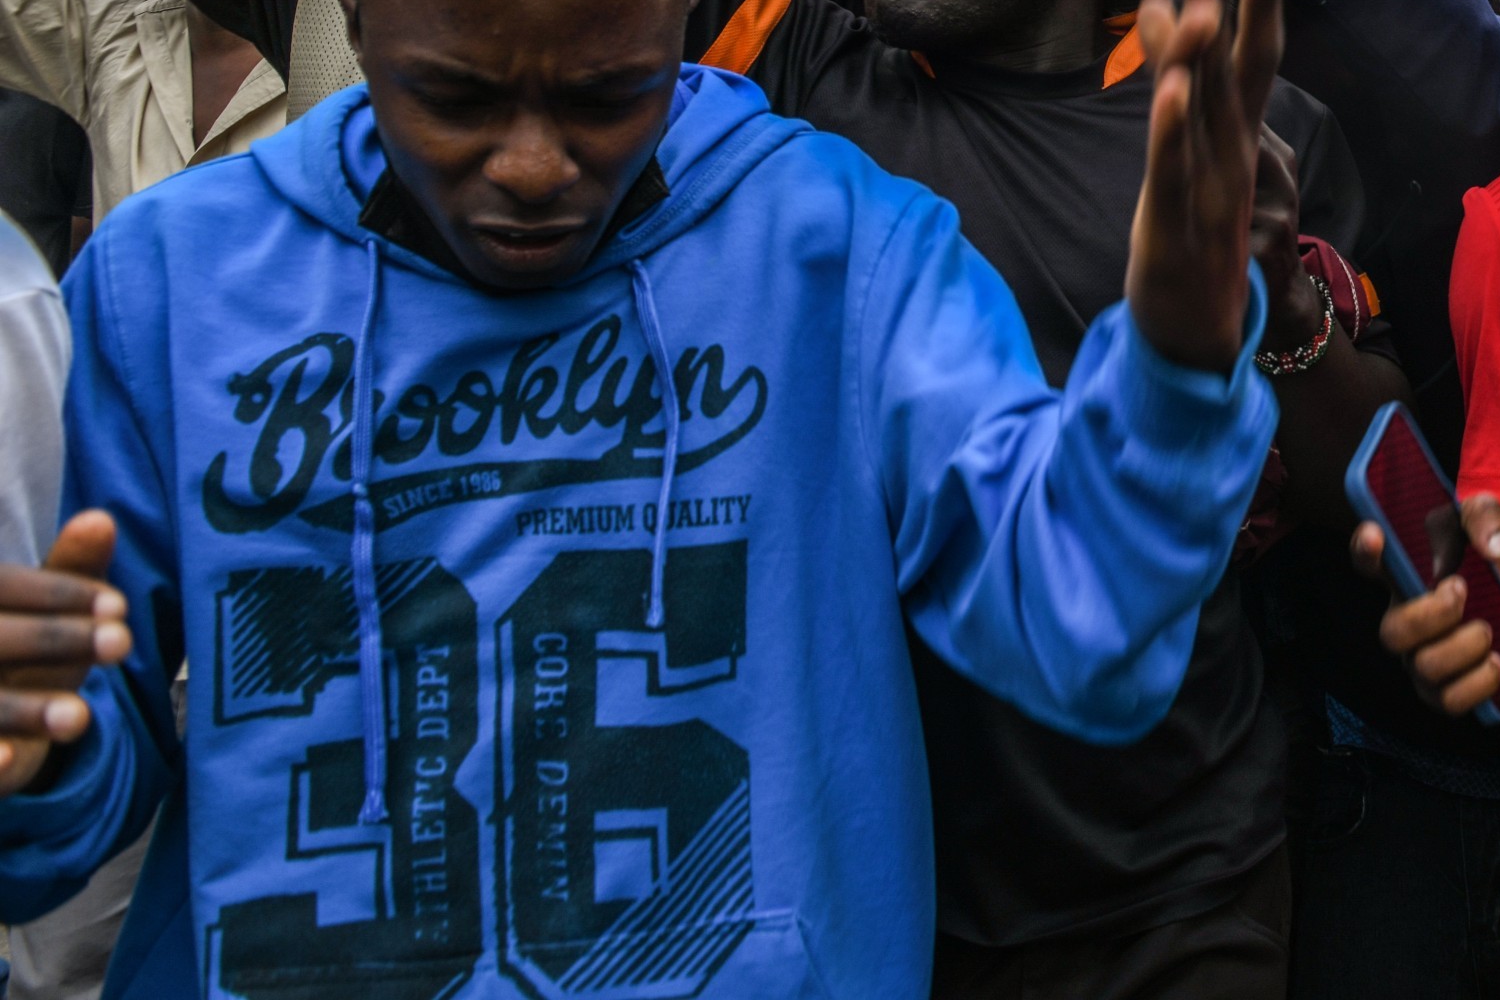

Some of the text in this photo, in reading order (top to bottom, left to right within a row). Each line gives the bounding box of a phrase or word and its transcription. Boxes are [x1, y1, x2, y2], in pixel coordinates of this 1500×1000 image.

[202, 312, 769, 536] Brooklyn
[382, 477, 455, 520] SINCE
[515, 504, 636, 538] PREMIUM
[415, 643, 451, 740] DEPT
